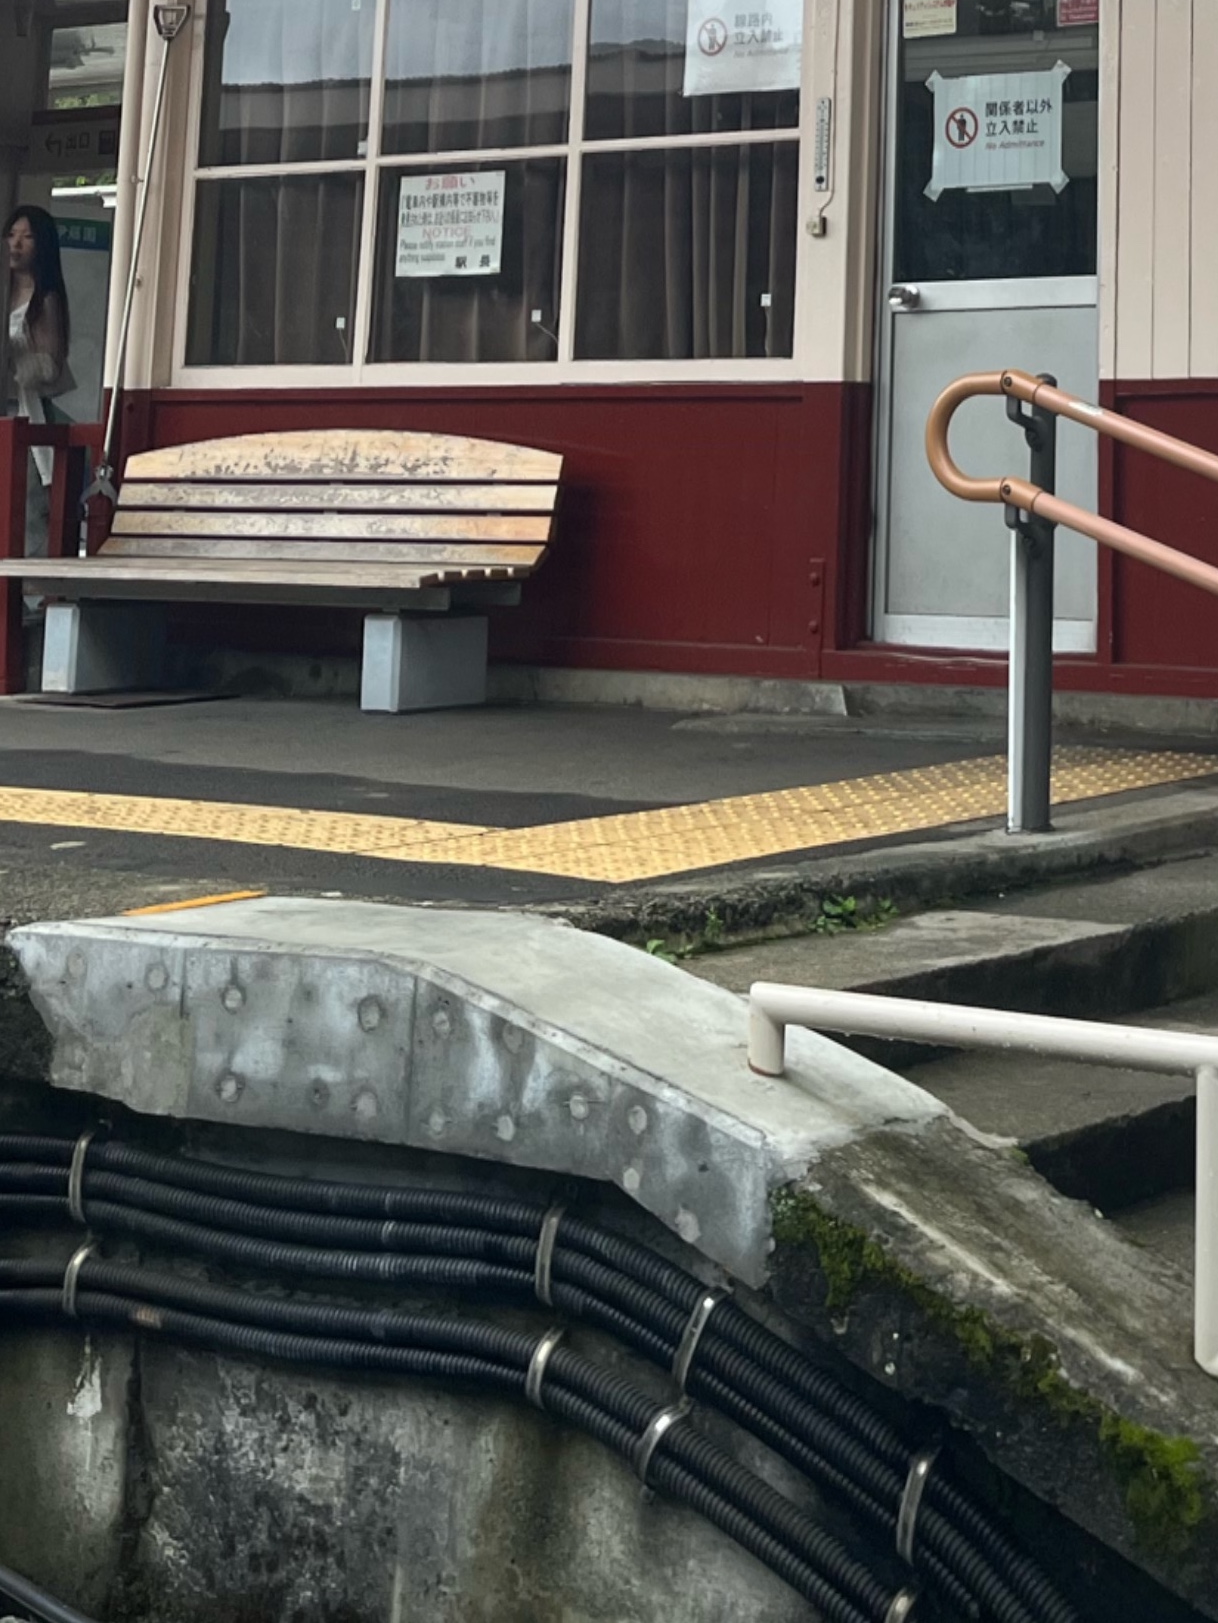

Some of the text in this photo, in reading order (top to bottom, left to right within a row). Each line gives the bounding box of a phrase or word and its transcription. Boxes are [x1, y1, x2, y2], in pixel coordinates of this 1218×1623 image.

[733, 27, 784, 45] 立入禁止
[985, 97, 1053, 118] 関係者以外
[985, 119, 1038, 137] 立入禁止
[985, 139, 1045, 150] No Admittance
[422, 226, 472, 238] NOTICE
